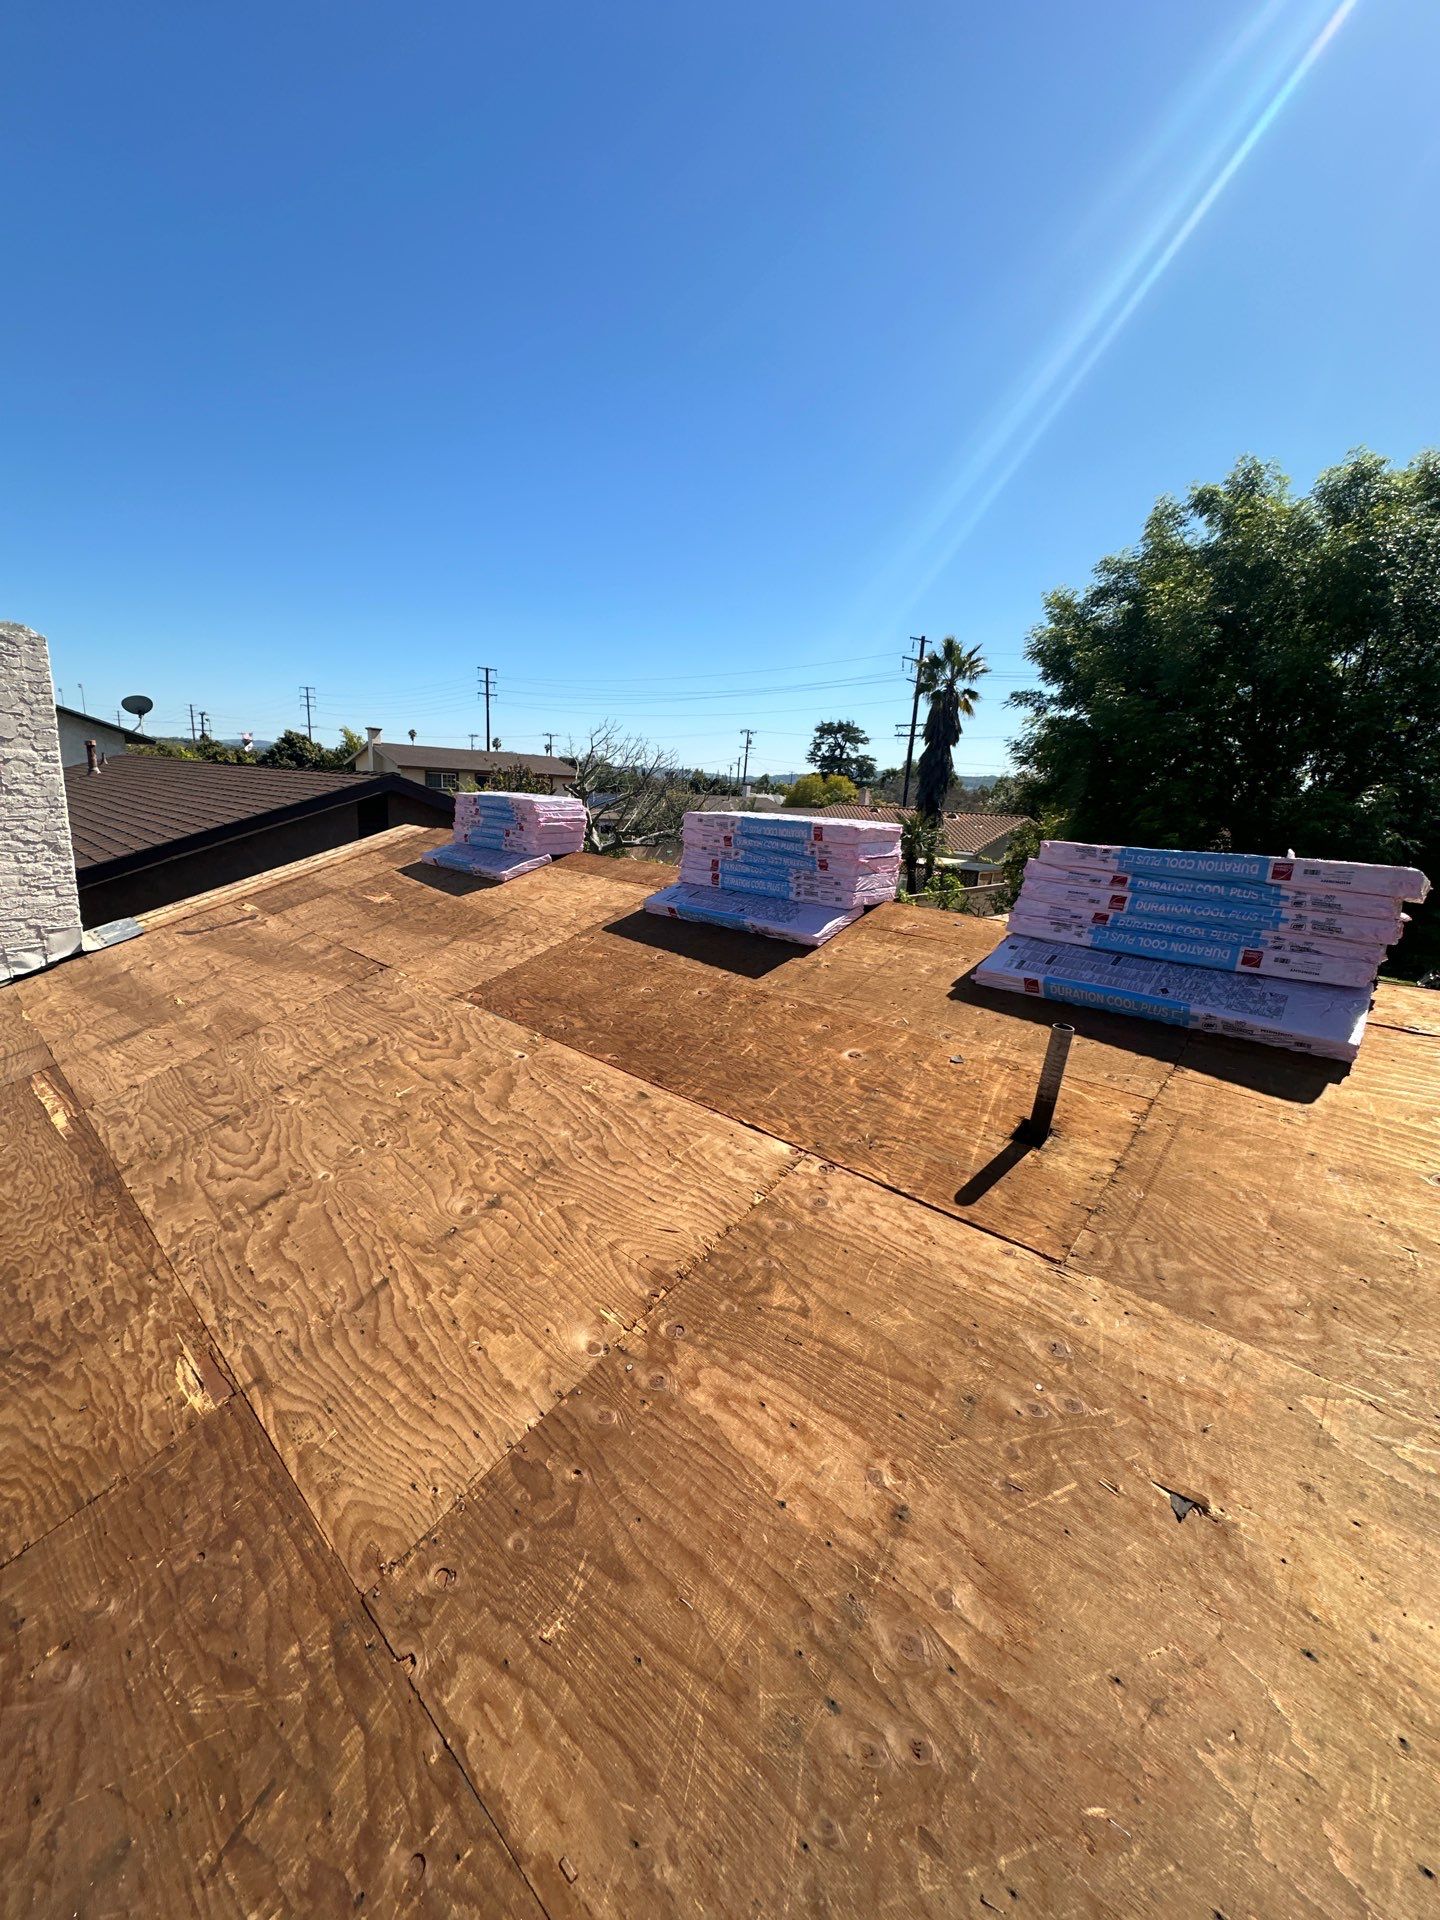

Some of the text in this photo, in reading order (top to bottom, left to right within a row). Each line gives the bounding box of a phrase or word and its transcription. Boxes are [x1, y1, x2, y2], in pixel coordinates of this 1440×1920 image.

[1136, 855, 1162, 867] PLUS
[1164, 856, 1196, 871] COOL
[1199, 860, 1260, 875] DURATION
[1136, 879, 1193, 893] DURATION
[1229, 889, 1259, 901] PLUS
[1135, 901, 1192, 915] DURATION
[1193, 906, 1226, 918] COOL
[1228, 911, 1259, 922] PLUS
[1116, 918, 1239, 943] DURATION COOL PLUS
[1110, 933, 1135, 945] PLUS
[1138, 937, 1168, 951] COOL
[1170, 943, 1231, 960] DURATION
[1049, 984, 1105, 1006] DURATION
[1106, 995, 1138, 1011] COOL
[1140, 1003, 1169, 1019] PLUS
